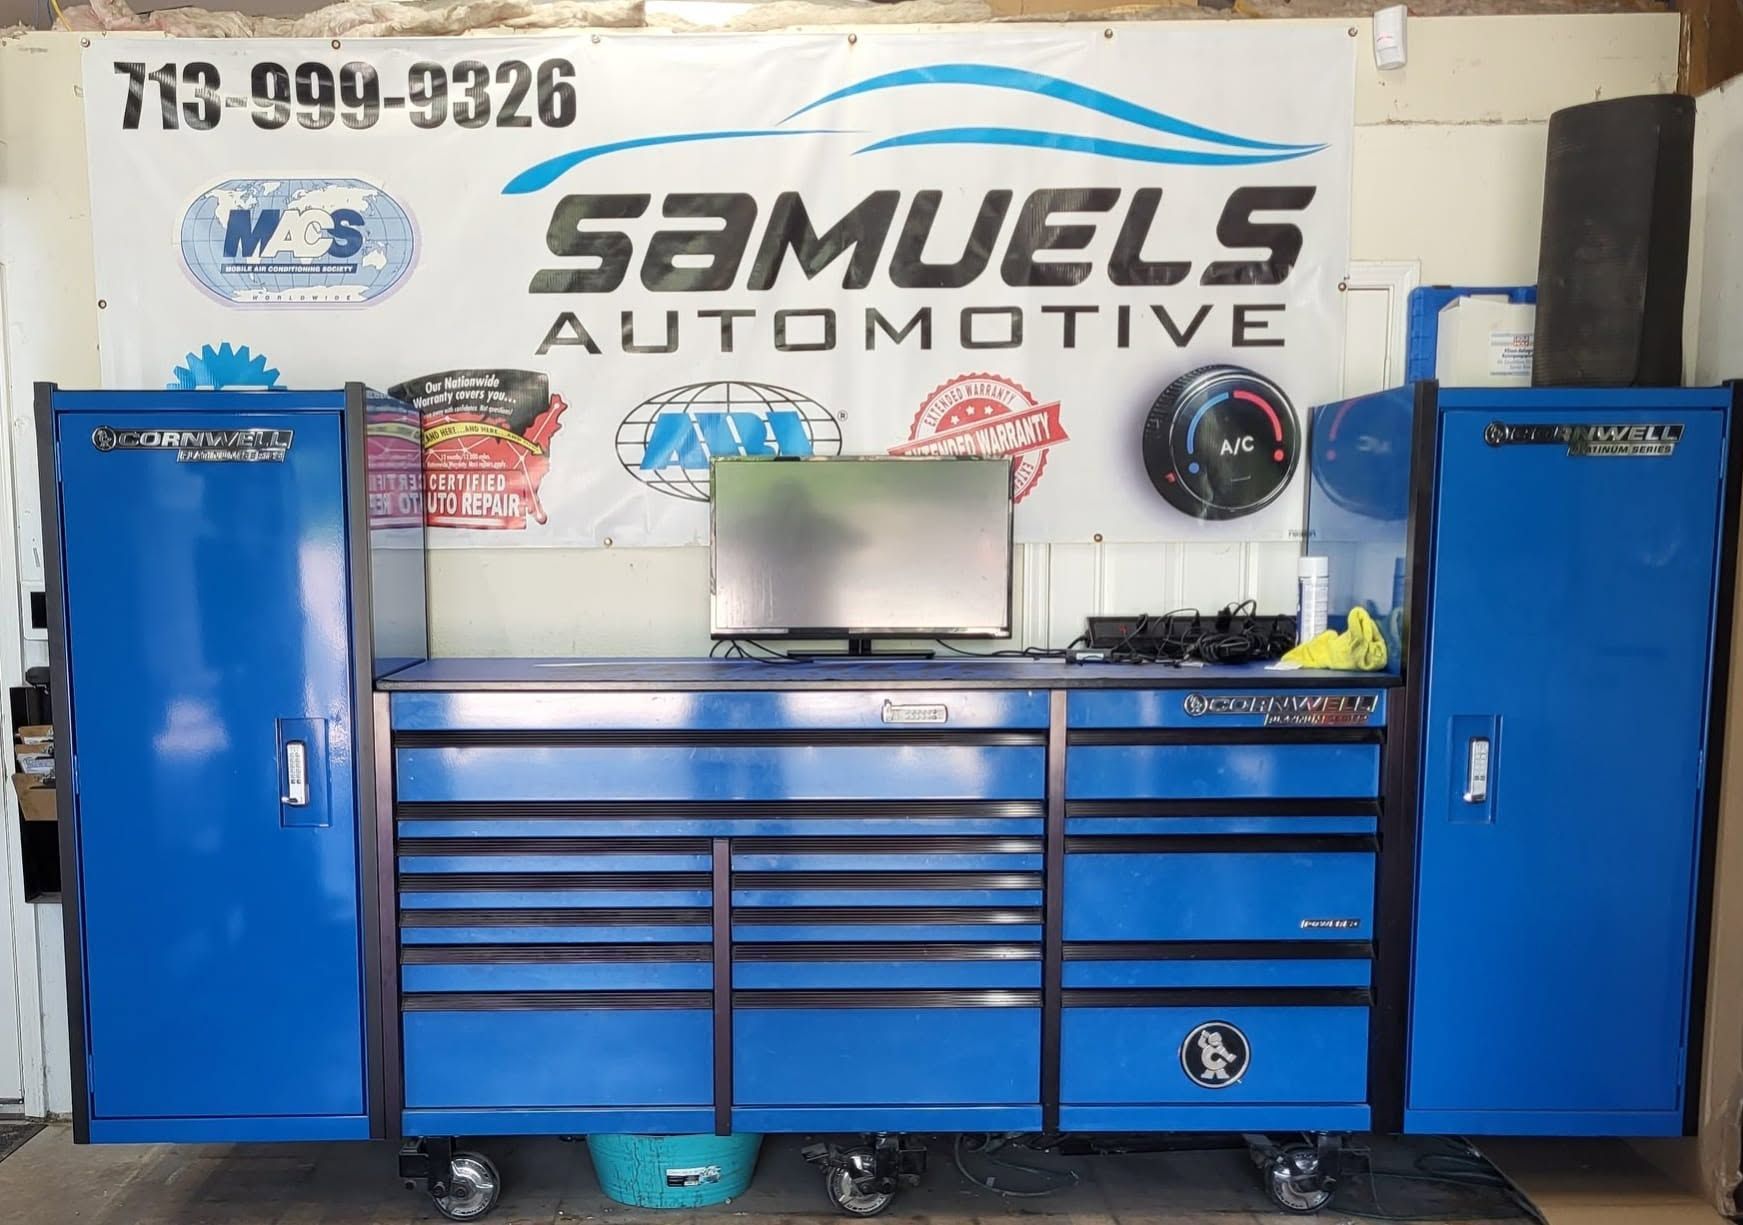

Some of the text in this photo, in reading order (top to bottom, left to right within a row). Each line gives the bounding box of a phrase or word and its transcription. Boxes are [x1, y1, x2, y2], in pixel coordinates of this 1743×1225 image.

[113, 58, 577, 131] 713-999-9326
[223, 208, 365, 258] MACS
[225, 265, 353, 273] MOBILE AIR CONDITIONING SOCIETY
[534, 304, 1286, 354] AUTOMOTIVE
[425, 373, 500, 394] Our Nationwide
[412, 391, 453, 409] Warranty
[455, 390, 485, 400] covers
[924, 383, 1018, 428] EXTENDED WARRANTY
[118, 431, 289, 448] CORNWELL
[975, 411, 1052, 457] WARRANTY
[1220, 435, 1255, 456] A/C
[430, 474, 506, 490] CERTIFIED
[427, 492, 521, 516] UTO REPAIR
[1208, 696, 1372, 712] CORNWELL
